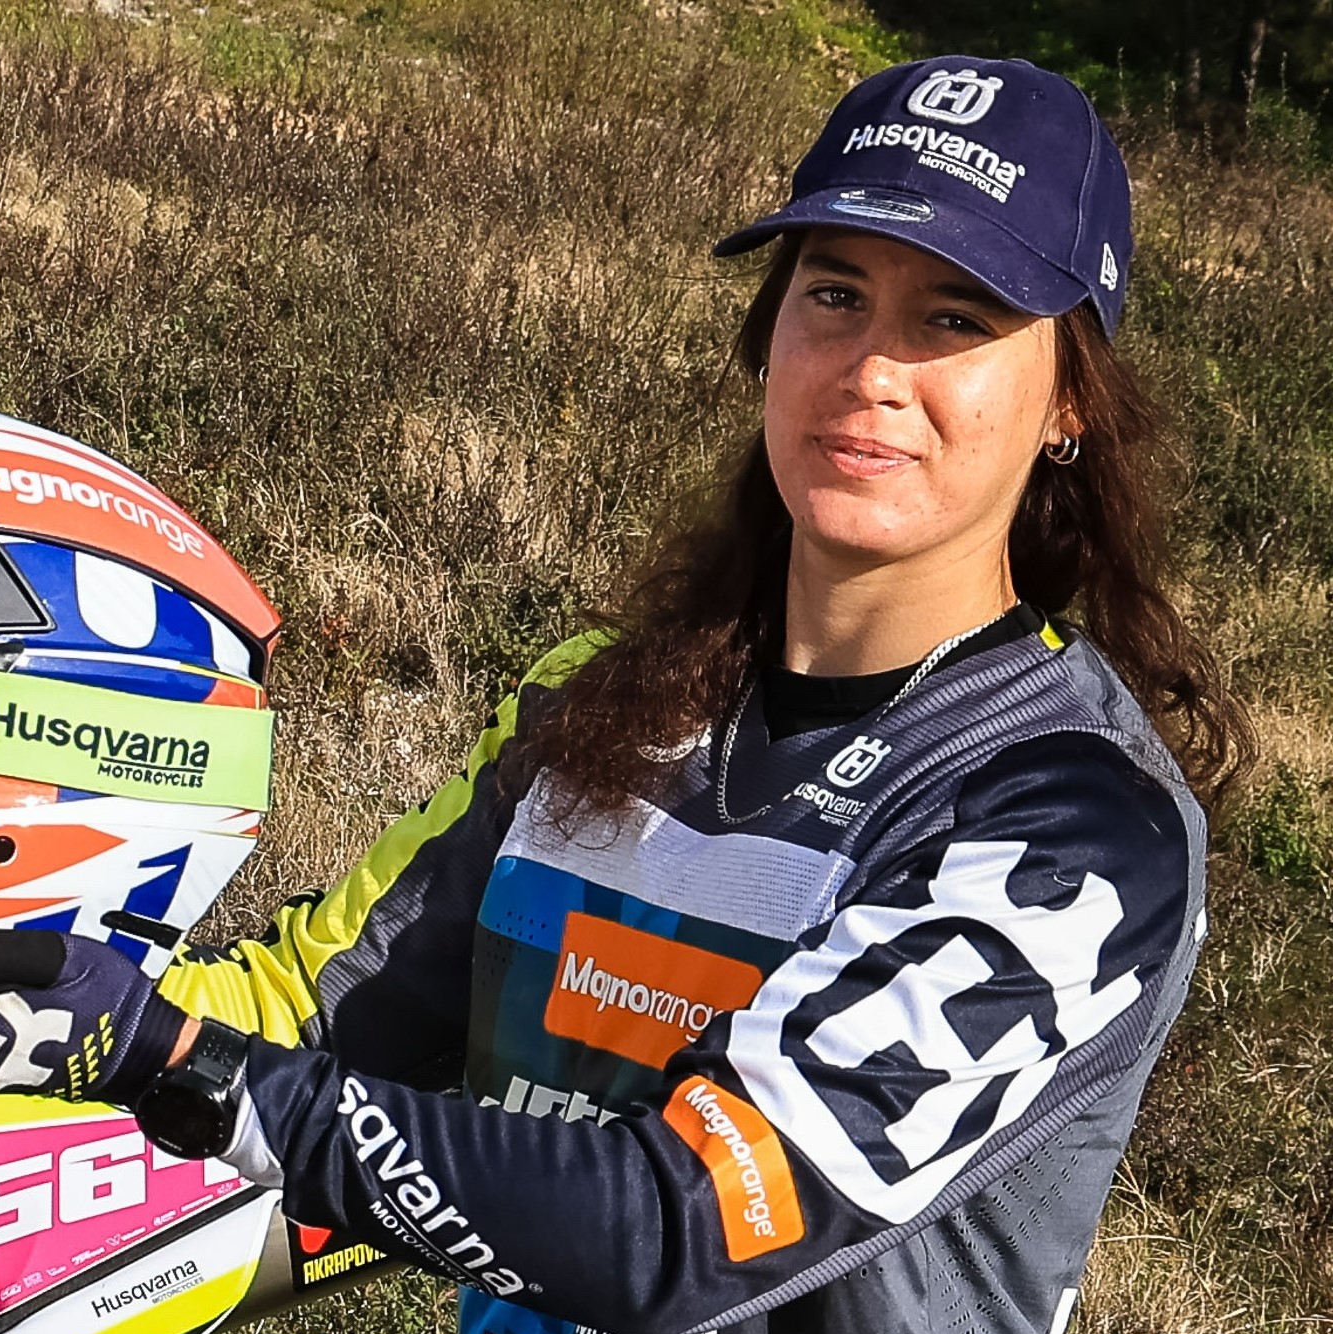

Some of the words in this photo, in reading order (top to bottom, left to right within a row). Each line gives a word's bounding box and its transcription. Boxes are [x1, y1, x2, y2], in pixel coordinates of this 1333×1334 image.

[842, 124, 1017, 188] Husqvarna
[917, 153, 1010, 204] MOTORCYCLES
[97, 763, 205, 789] MOTORCYCLES
[336, 1075, 525, 1297] sqvarna
[684, 1083, 775, 1238] Magnorange
[90, 1257, 200, 1320] Husqvarna
[302, 1242, 388, 1286] AKRAPOV
